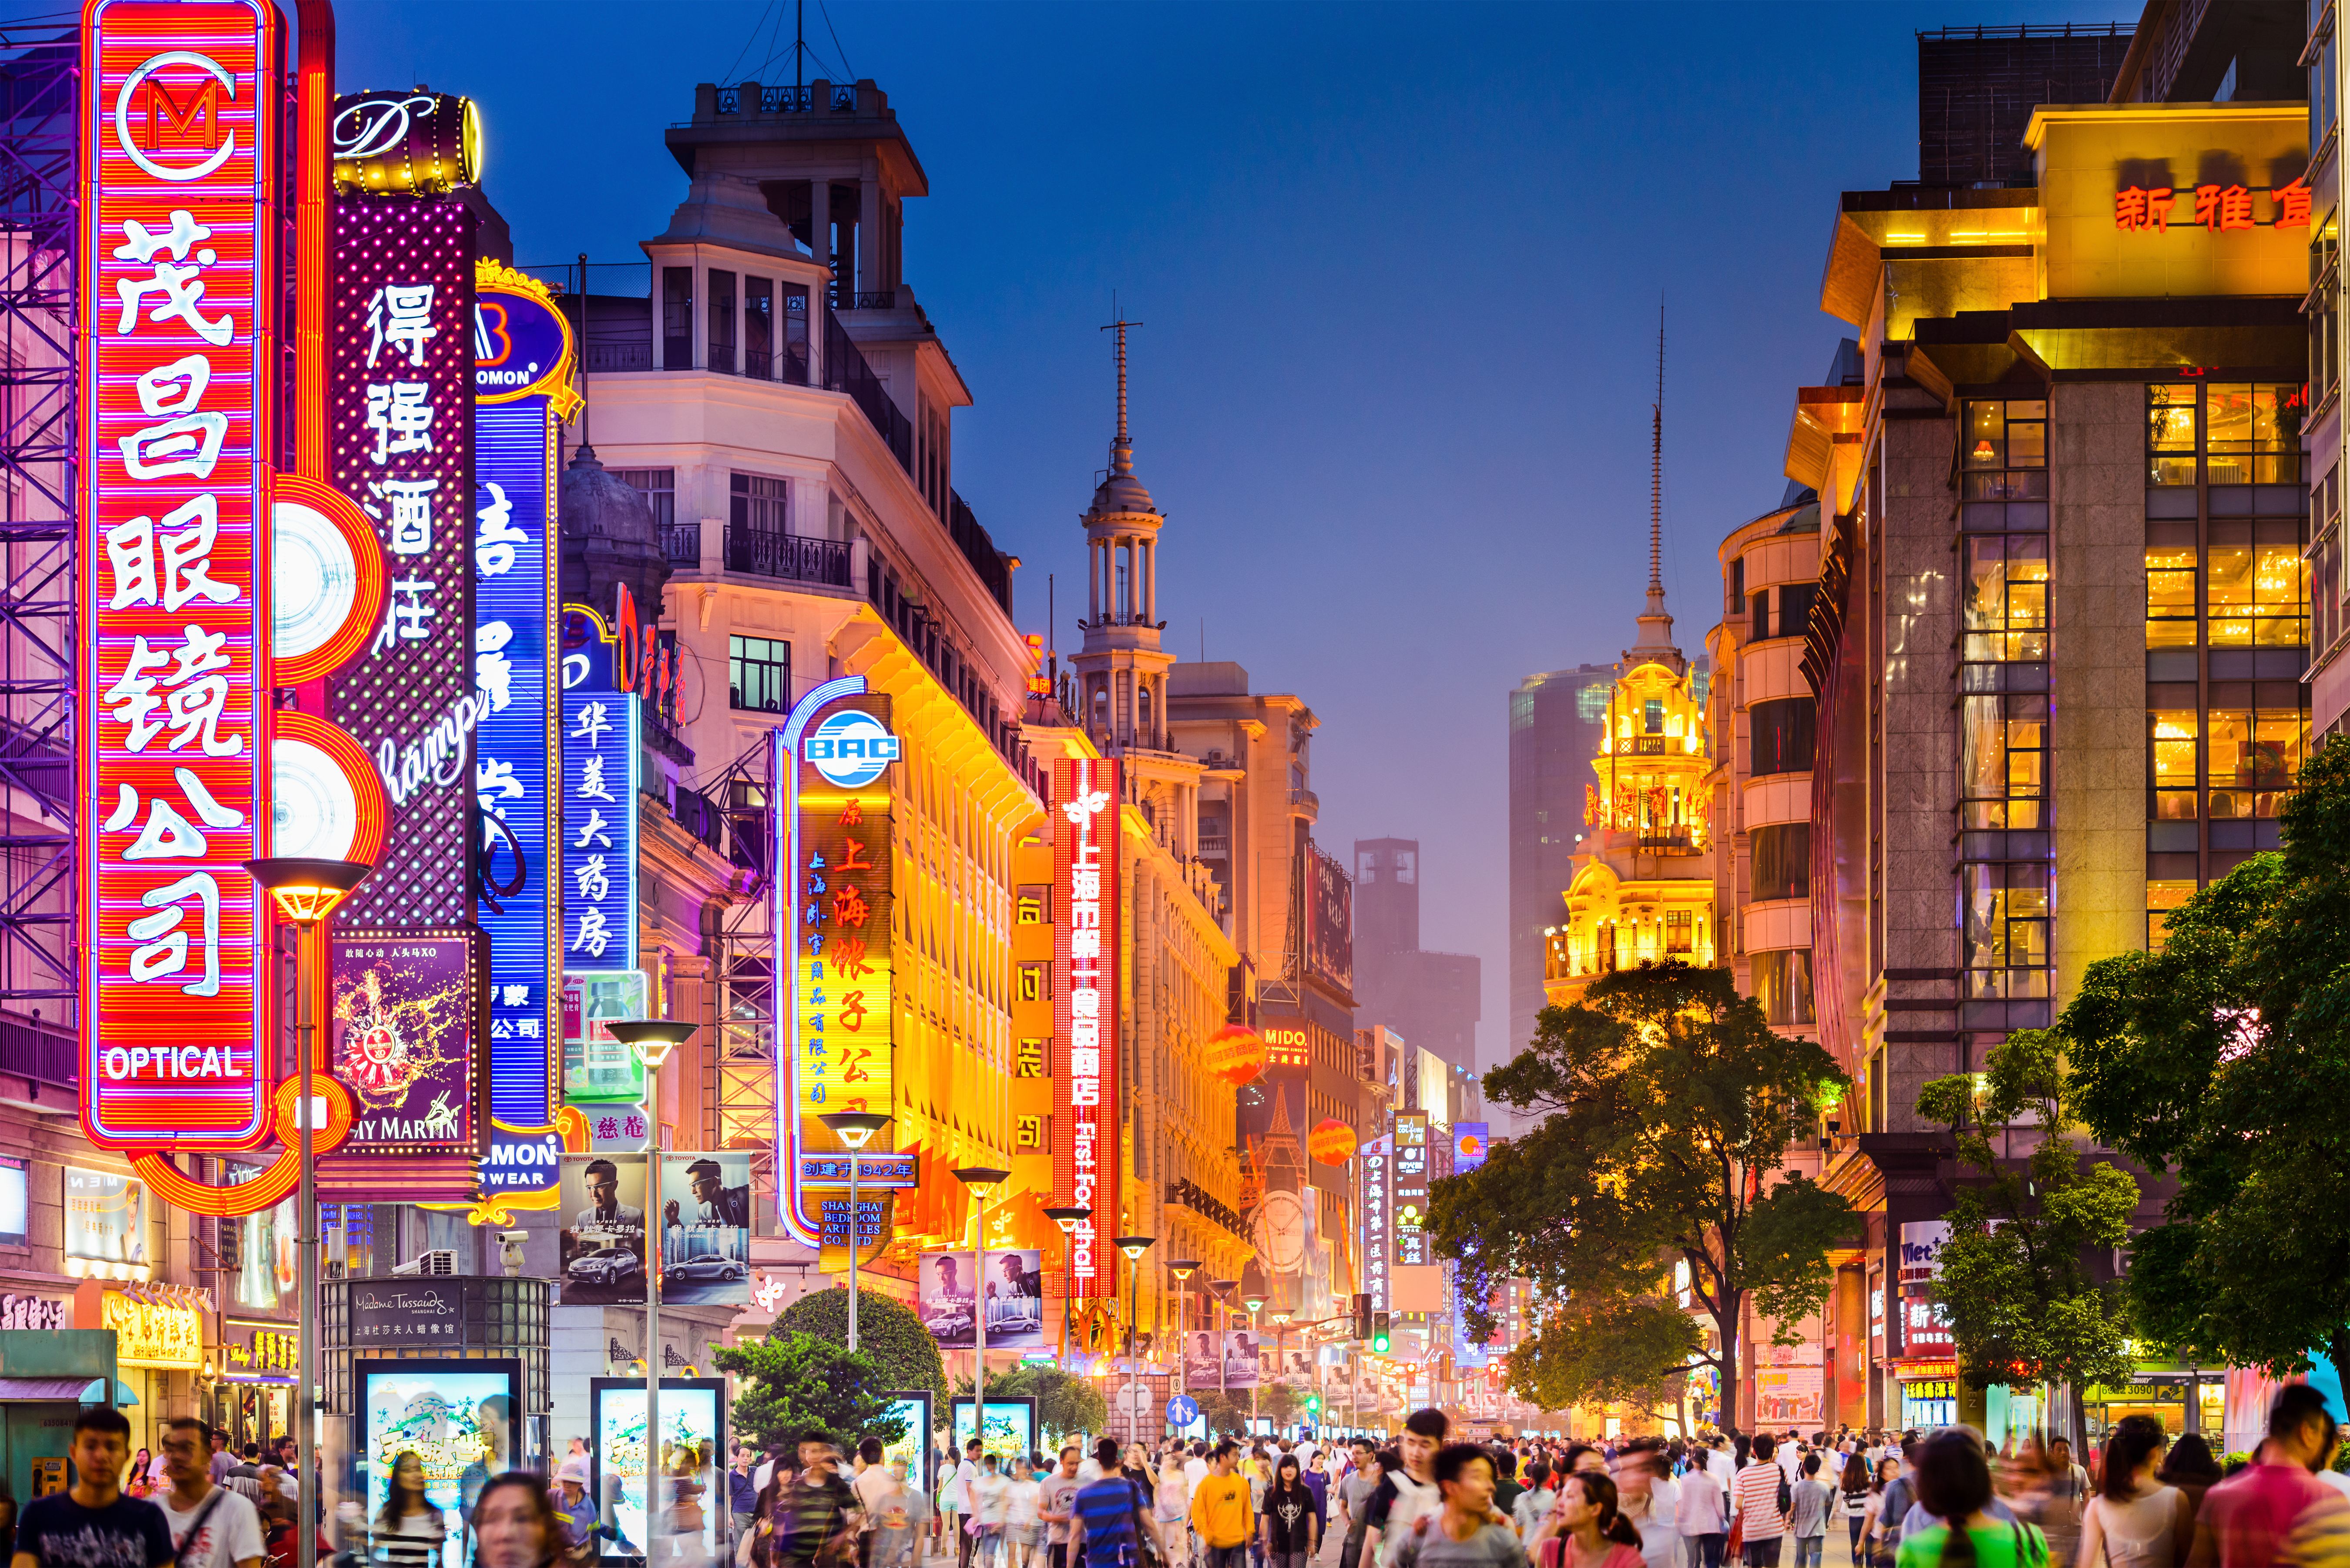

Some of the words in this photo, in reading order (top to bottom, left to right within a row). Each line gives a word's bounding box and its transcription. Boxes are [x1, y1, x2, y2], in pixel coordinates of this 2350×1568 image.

[2115, 177, 2311, 233] 新雅食
[476, 371, 530, 385] OMON
[104, 210, 245, 996] 茂昌眼镜公司
[1028, 677, 1051, 694] 集团
[807, 738, 896, 759] BAC
[571, 701, 615, 957] 华美大药房
[346, 949, 384, 958] 敢随心动
[806, 851, 827, 1104] 上海卧室用品有限公司
[1071, 840, 1101, 1106] 上海市第一食品商店
[1266, 1029, 1306, 1046] MIDO
[106, 1046, 242, 1080] OPTICAL
[591, 1115, 645, 1140] 慈菴
[478, 1144, 557, 1166] MON
[1075, 1123, 1095, 1168] First
[493, 1173, 544, 1184] WEAR
[802, 1162, 913, 1178] 创建于1942年
[822, 1201, 883, 1212] SHANGHAI
[849, 1236, 872, 1246] TD
[1368, 1169, 1385, 1309] 上海市第一医药商店
[1404, 1236, 1422, 1264] 真丝
[356, 1293, 393, 1310] Madame
[392, 1291, 447, 1314] Tussauds
[355, 1323, 454, 1336] 上海杜莎夫人蜡像馆
[2128, 1385, 2152, 1394] 3090
